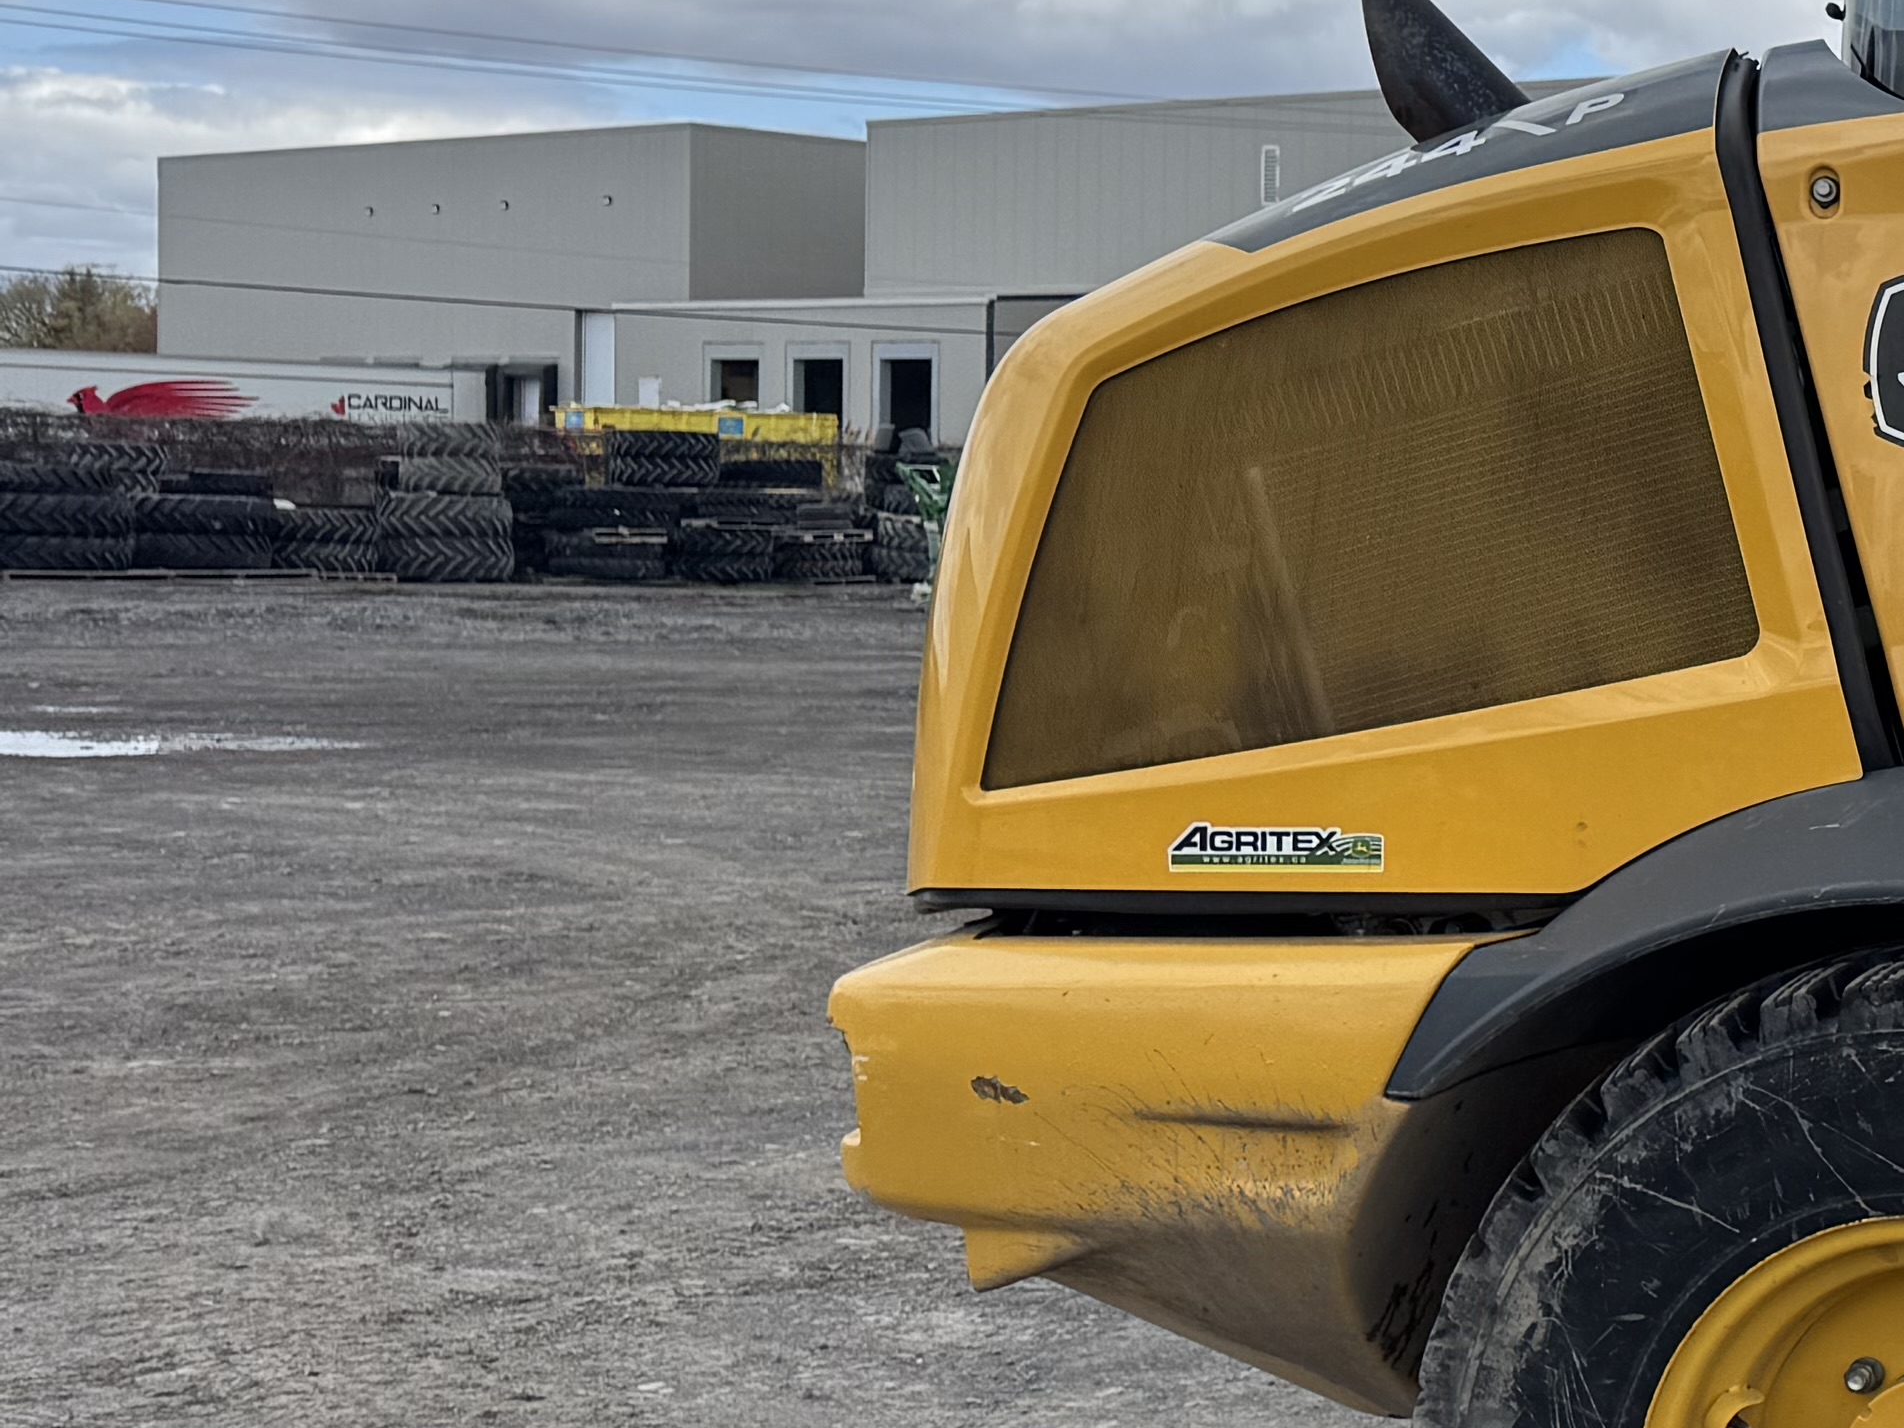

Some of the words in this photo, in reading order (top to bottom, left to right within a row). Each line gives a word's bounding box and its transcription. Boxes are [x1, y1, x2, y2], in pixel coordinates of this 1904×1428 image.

[347, 393, 440, 412] CARDINAL
[1172, 825, 1338, 855] AGRITEX
[1202, 855, 1307, 865] www.agritex.ca
